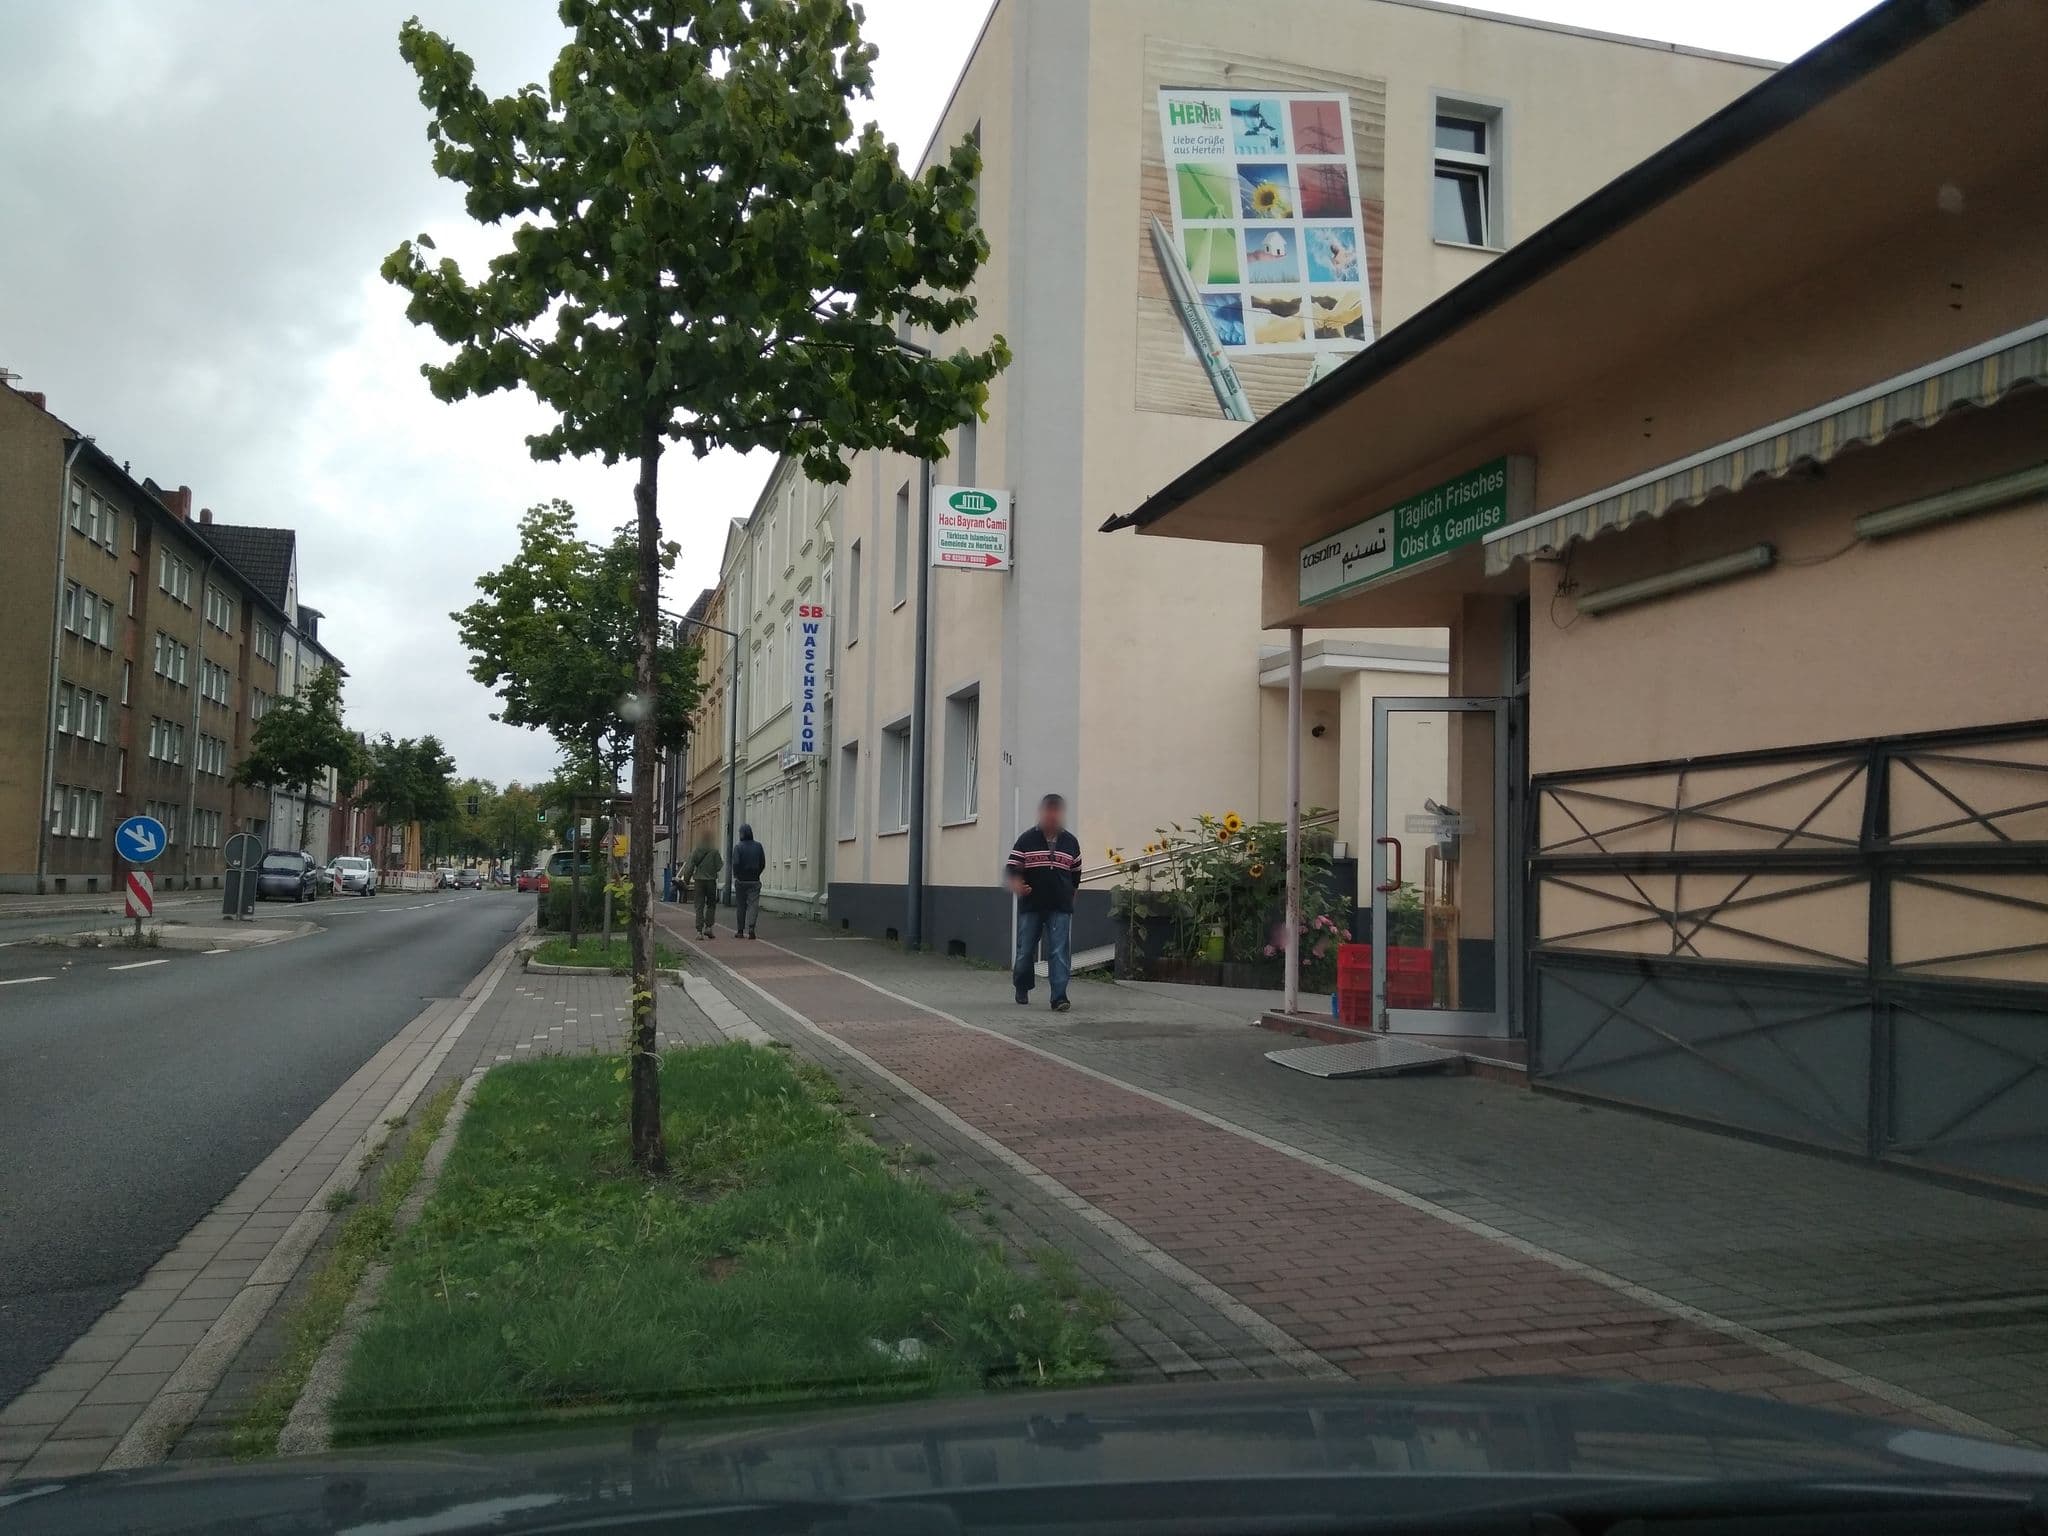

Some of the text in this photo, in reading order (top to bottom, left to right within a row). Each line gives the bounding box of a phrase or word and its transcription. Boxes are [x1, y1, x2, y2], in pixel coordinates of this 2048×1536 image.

[1173, 136, 1225, 147] Liebe Grüße
[1191, 145, 1225, 155] Herten!
[1398, 470, 1504, 529] Täglich Frisches
[957, 515, 985, 529] Bayram
[986, 517, 1007, 530] Camii
[946, 532, 968, 541] Türkisch
[1400, 504, 1501, 559] Obst & Gemüse
[941, 540, 967, 548] Gemeinde
[798, 605, 824, 618] SB
[801, 623, 819, 753] WASCHSALON
